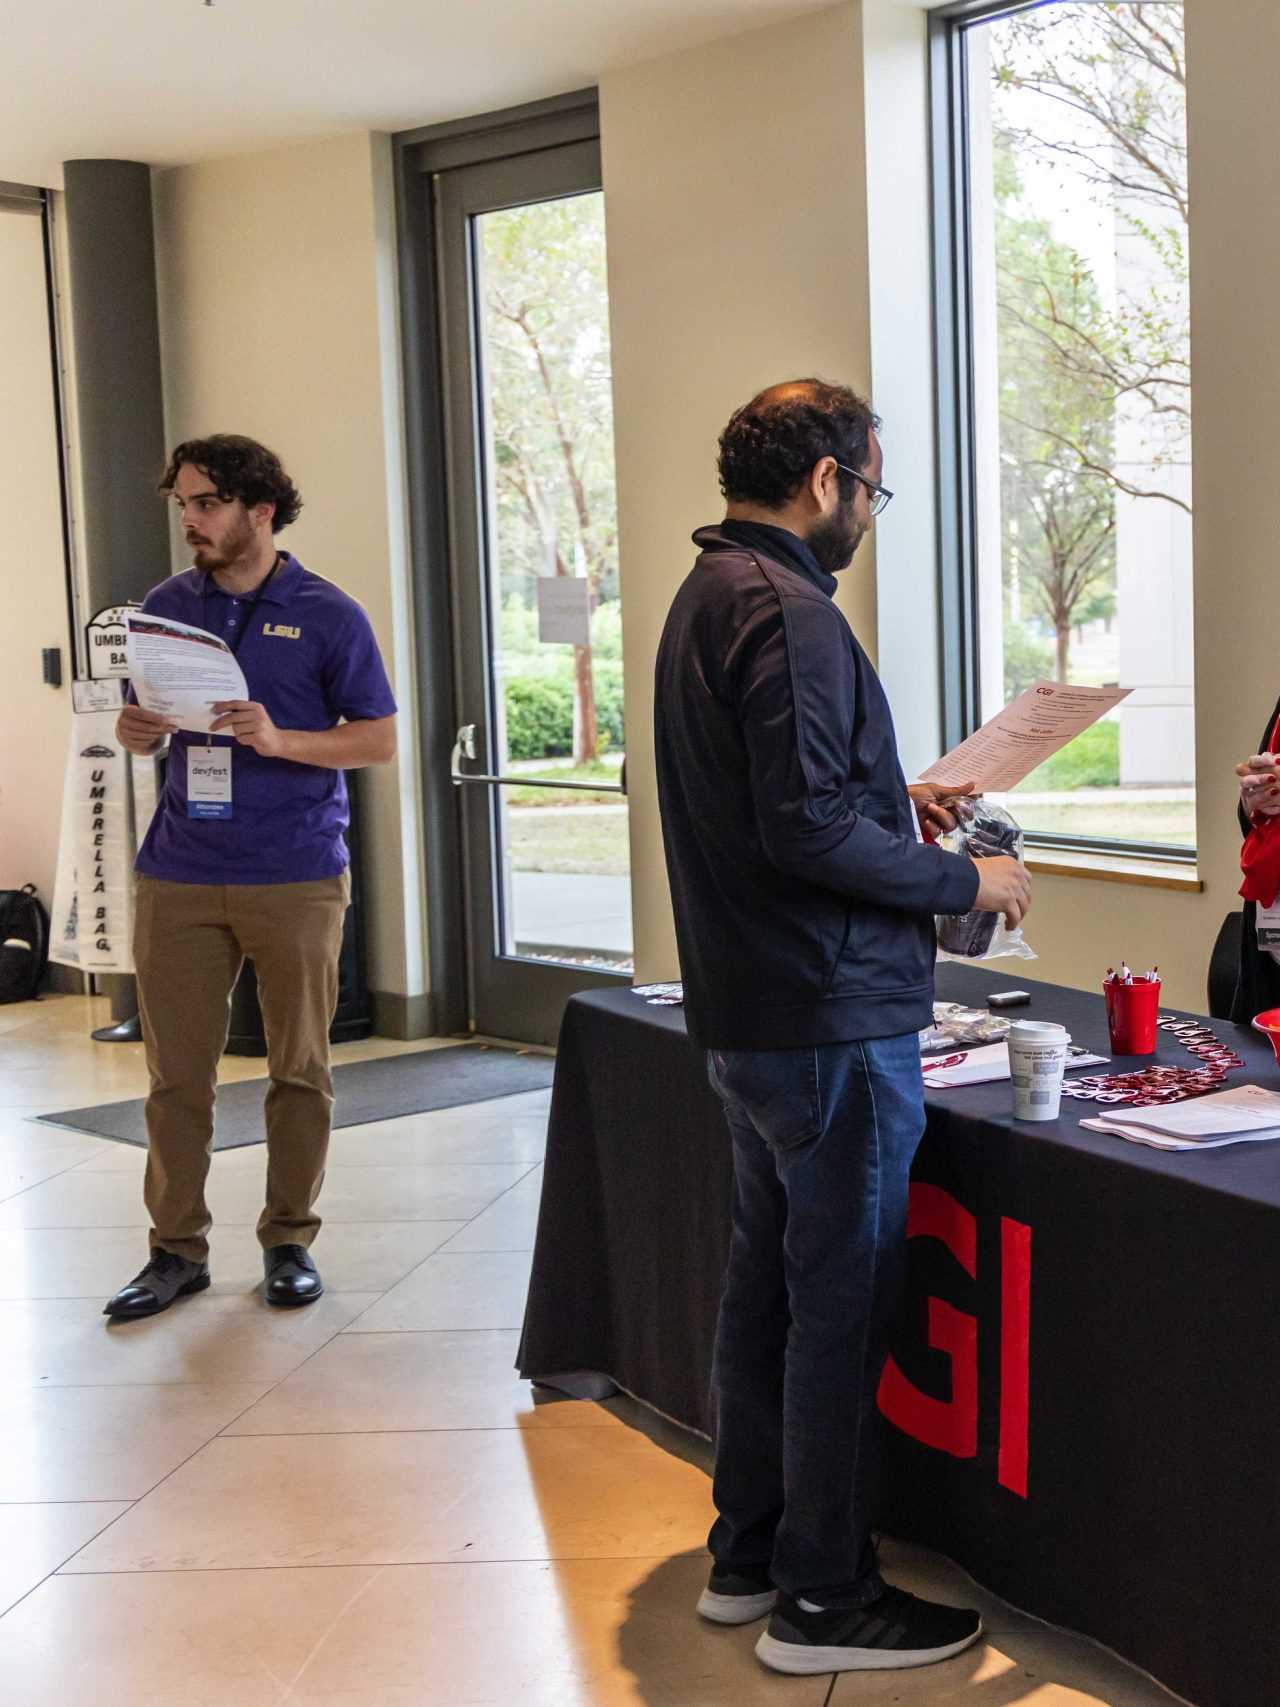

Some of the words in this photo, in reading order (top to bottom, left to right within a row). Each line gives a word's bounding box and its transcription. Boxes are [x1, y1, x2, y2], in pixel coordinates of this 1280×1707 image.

[263, 623, 301, 639] LSU
[89, 769, 106, 892] UMBRELLA
[876, 1181, 1032, 1501] GI
